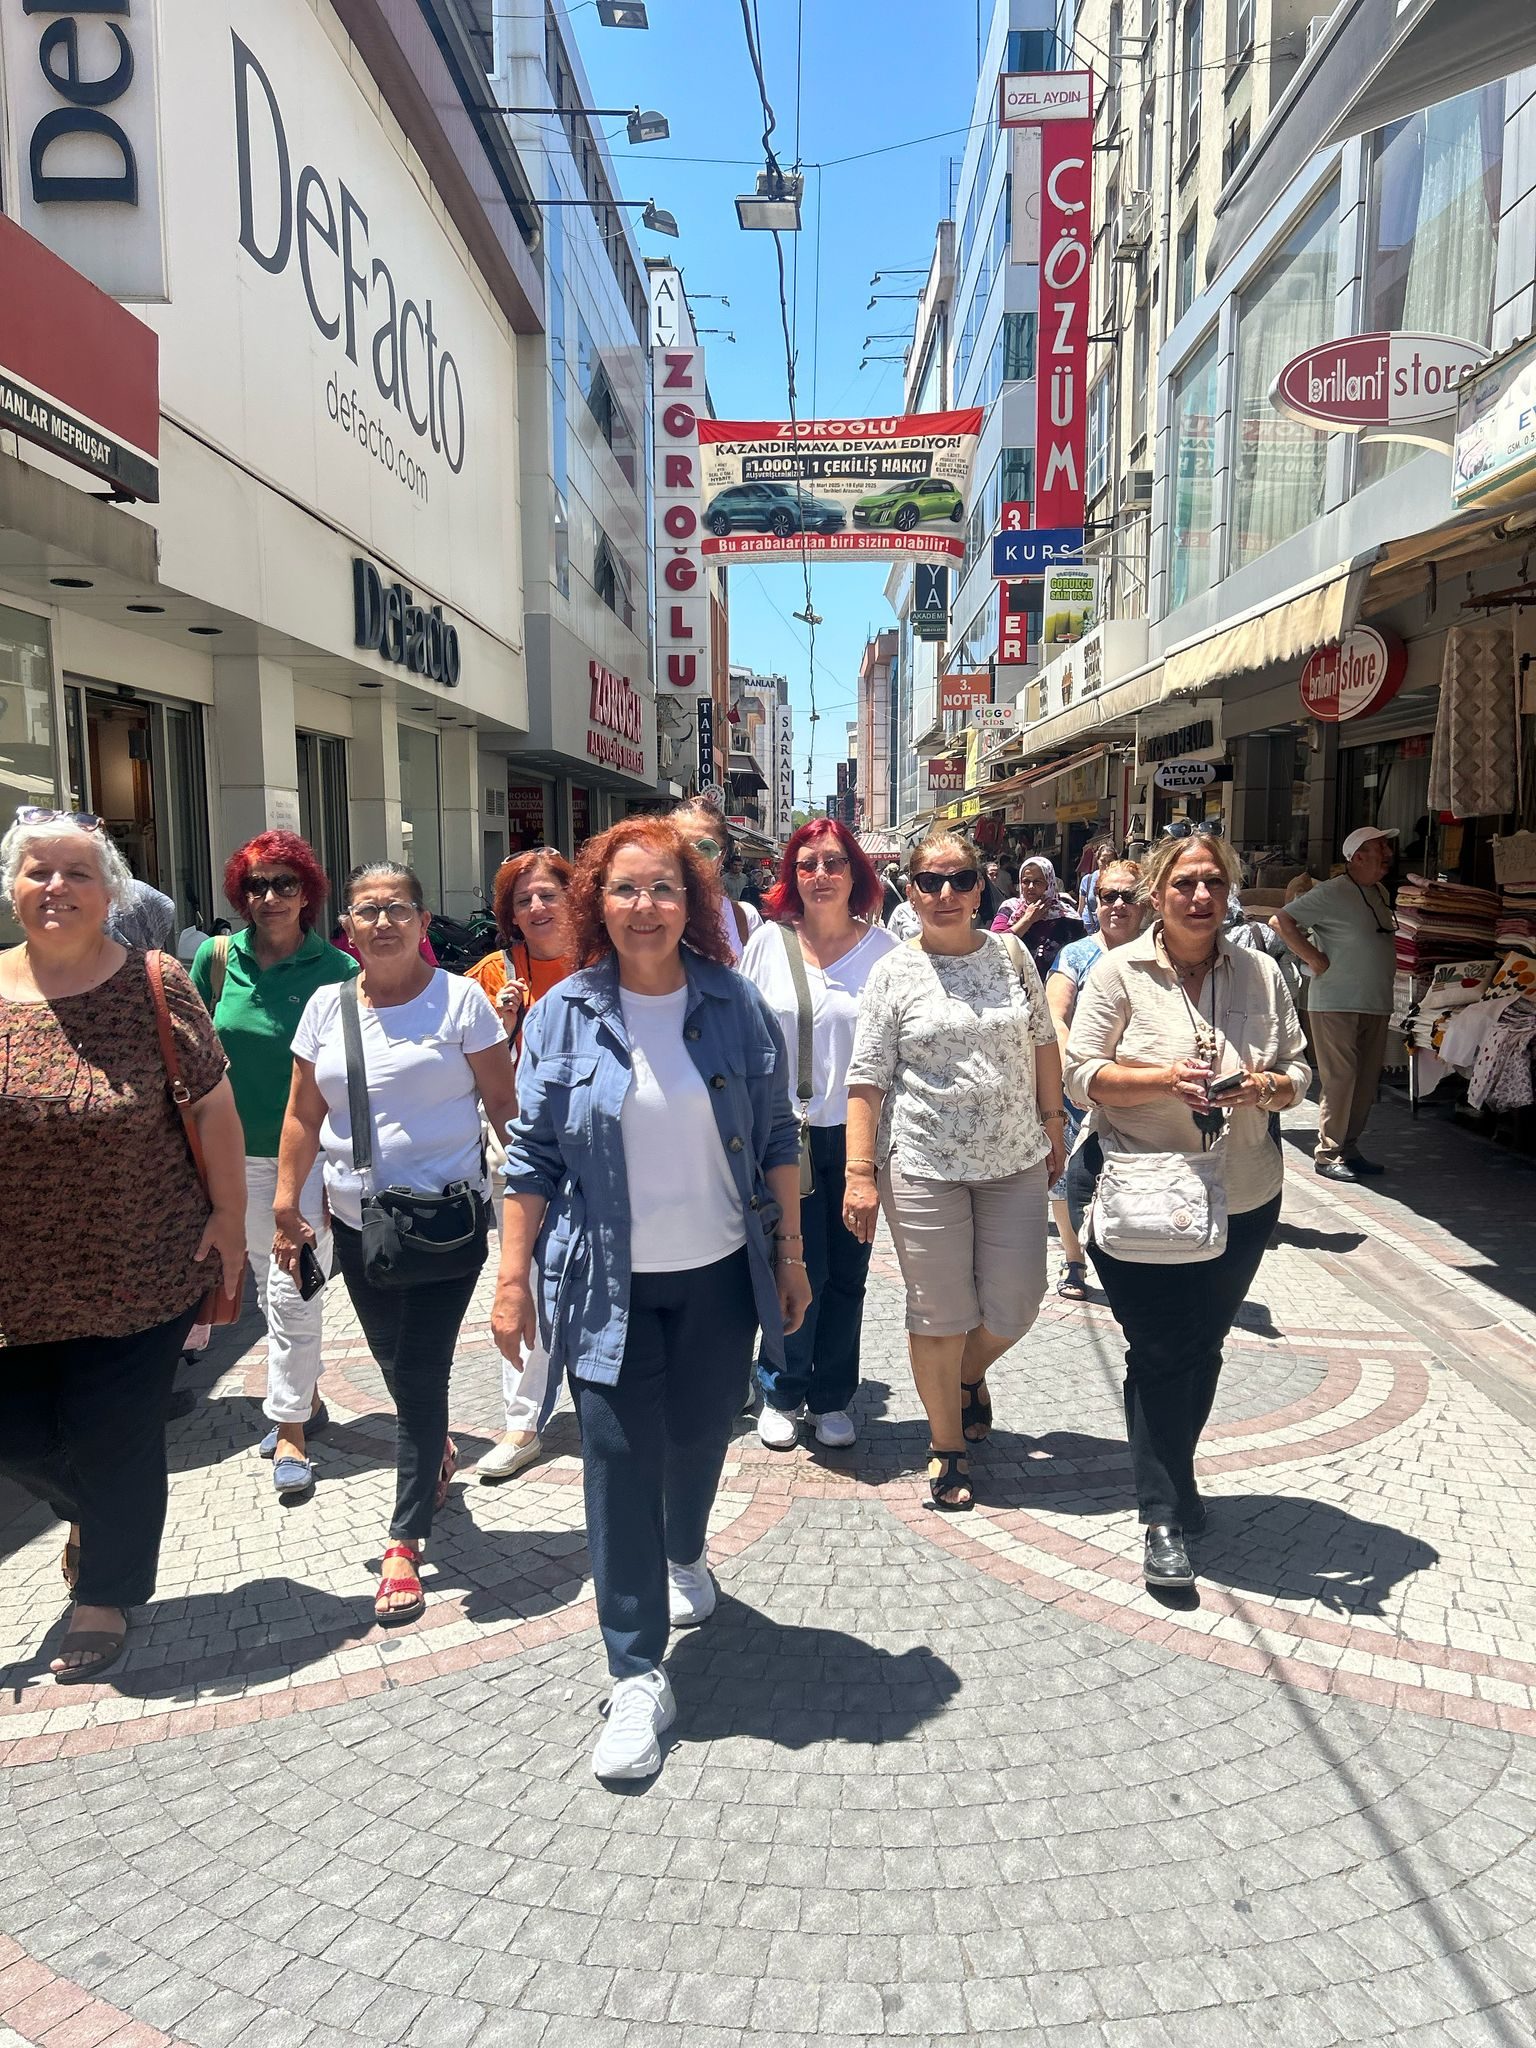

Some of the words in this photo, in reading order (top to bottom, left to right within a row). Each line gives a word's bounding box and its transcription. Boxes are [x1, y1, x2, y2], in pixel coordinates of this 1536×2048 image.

[23, 0, 138, 206] De
[1008, 91, 1041, 105] ÖZEL
[1043, 91, 1081, 104] AYDIN
[230, 26, 465, 475] DeFacto
[1043, 158, 1087, 491] ÇÖZÜM
[1308, 357, 1385, 403] brillant
[52, 414, 111, 465] MEFRUŞAT
[327, 371, 429, 504] defacto.com
[716, 441, 839, 456] KAZANDIRMAYA
[847, 439, 897, 452] DEVAM
[901, 435, 962, 449] EDİYOR!
[823, 456, 877, 477] ÇEKİLİŞ
[882, 458, 927, 474] HAKKI
[663, 354, 698, 687] ZOROĞLU
[718, 539, 737, 552] Bu
[741, 537, 826, 551] arabalardan
[830, 536, 854, 549] biri
[858, 537, 890, 549] sizin
[894, 537, 950, 552] olabilir!
[1006, 544, 1070, 560] KURS
[1071, 591, 1093, 601] USTA
[1341, 645, 1376, 691] store
[943, 694, 988, 706] NOTER
[700, 703, 711, 788] TATTOO
[780, 716, 791, 823] SARANLAR
[929, 773, 965, 789] NOTE
[1161, 764, 1208, 776] ATÇALI
[1163, 777, 1206, 786] HELVA
